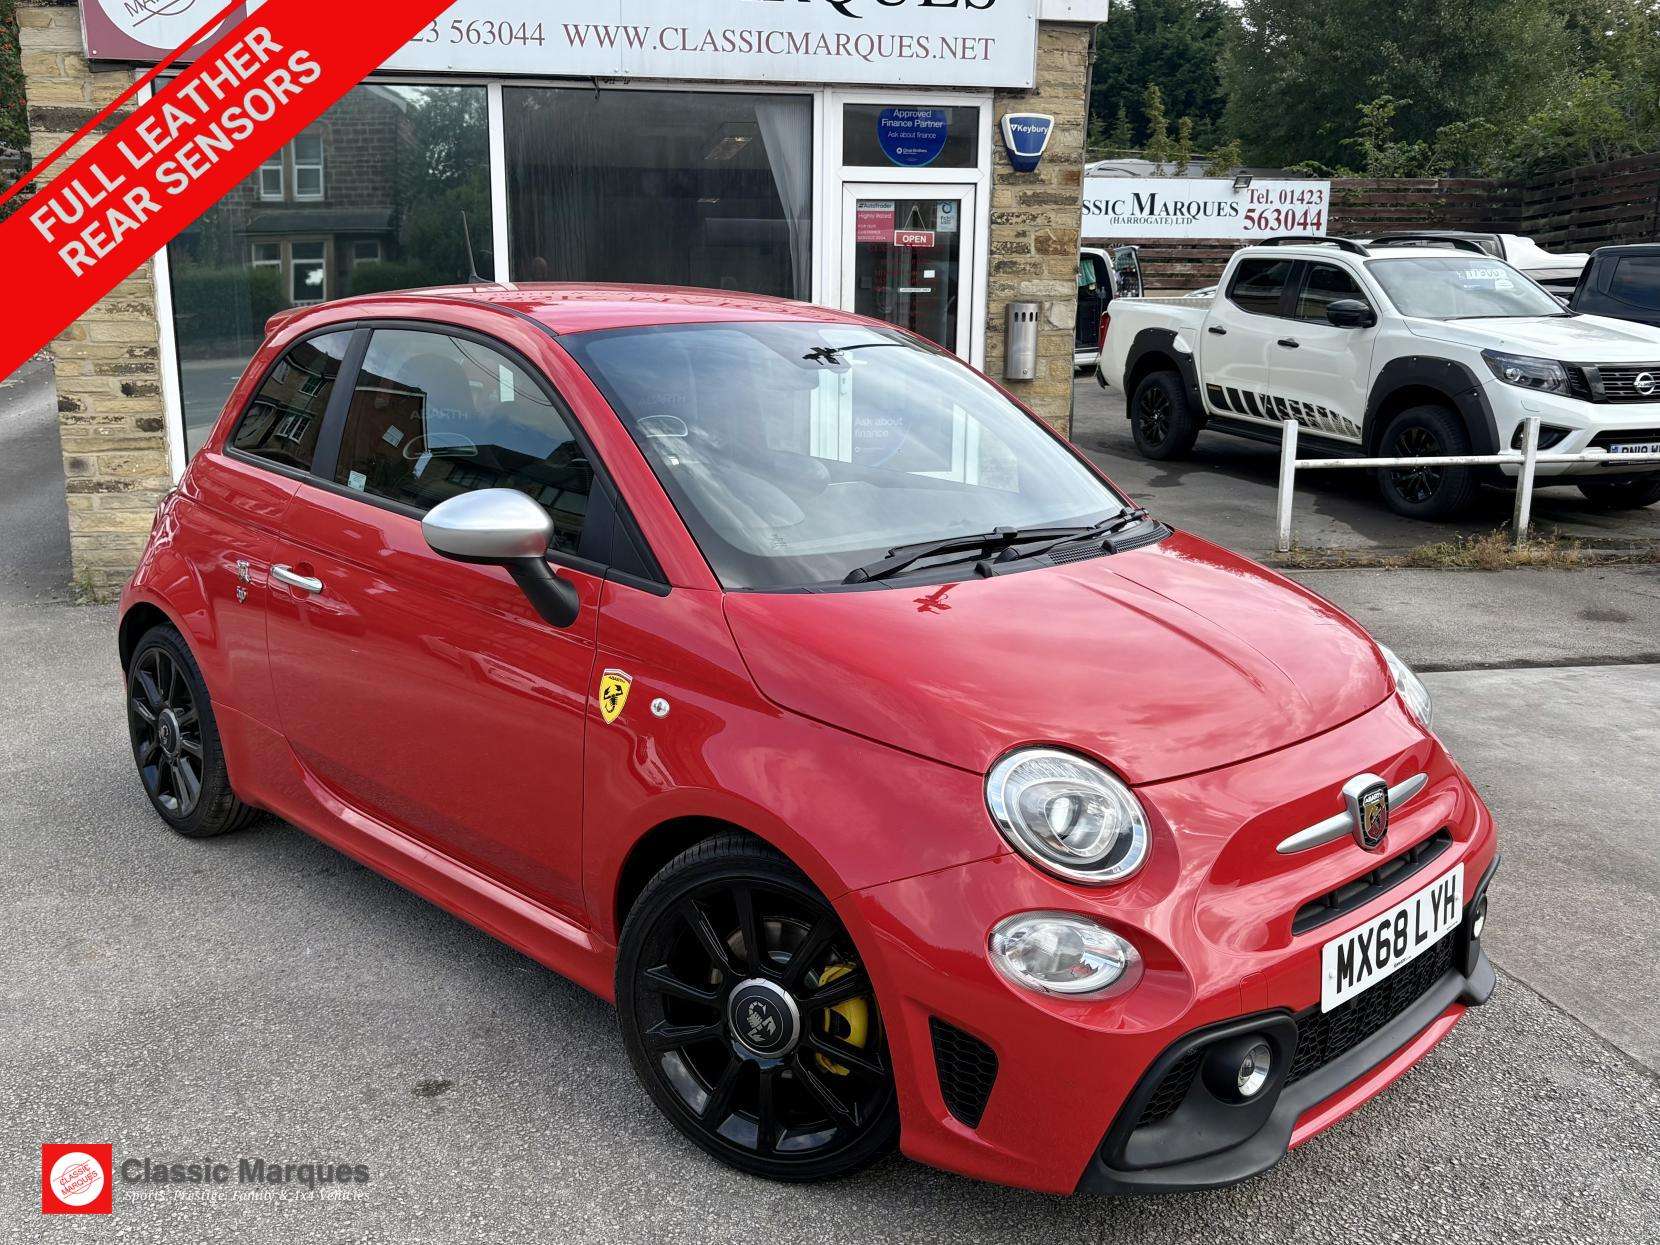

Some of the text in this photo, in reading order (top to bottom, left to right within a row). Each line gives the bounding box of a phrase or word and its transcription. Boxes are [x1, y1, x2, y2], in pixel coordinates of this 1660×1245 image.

[449, 19, 546, 47] 563044
[561, 23, 996, 63] WWW.CLASSICMARQUES.NET
[893, 108, 932, 119] Approved
[881, 118, 944, 129] Finance Partner
[1017, 124, 1049, 135] Keybury
[887, 130, 937, 139] Ask about finance
[1246, 188, 1323, 205] Tel. 01423
[1081, 192, 1240, 221] SSIC MARQUES
[1109, 216, 1194, 226] (HARROGATE) LTD
[1243, 208, 1323, 231] 563044
[902, 235, 927, 243] OPEN
[1336, 874, 1457, 995] MX68 LYH
